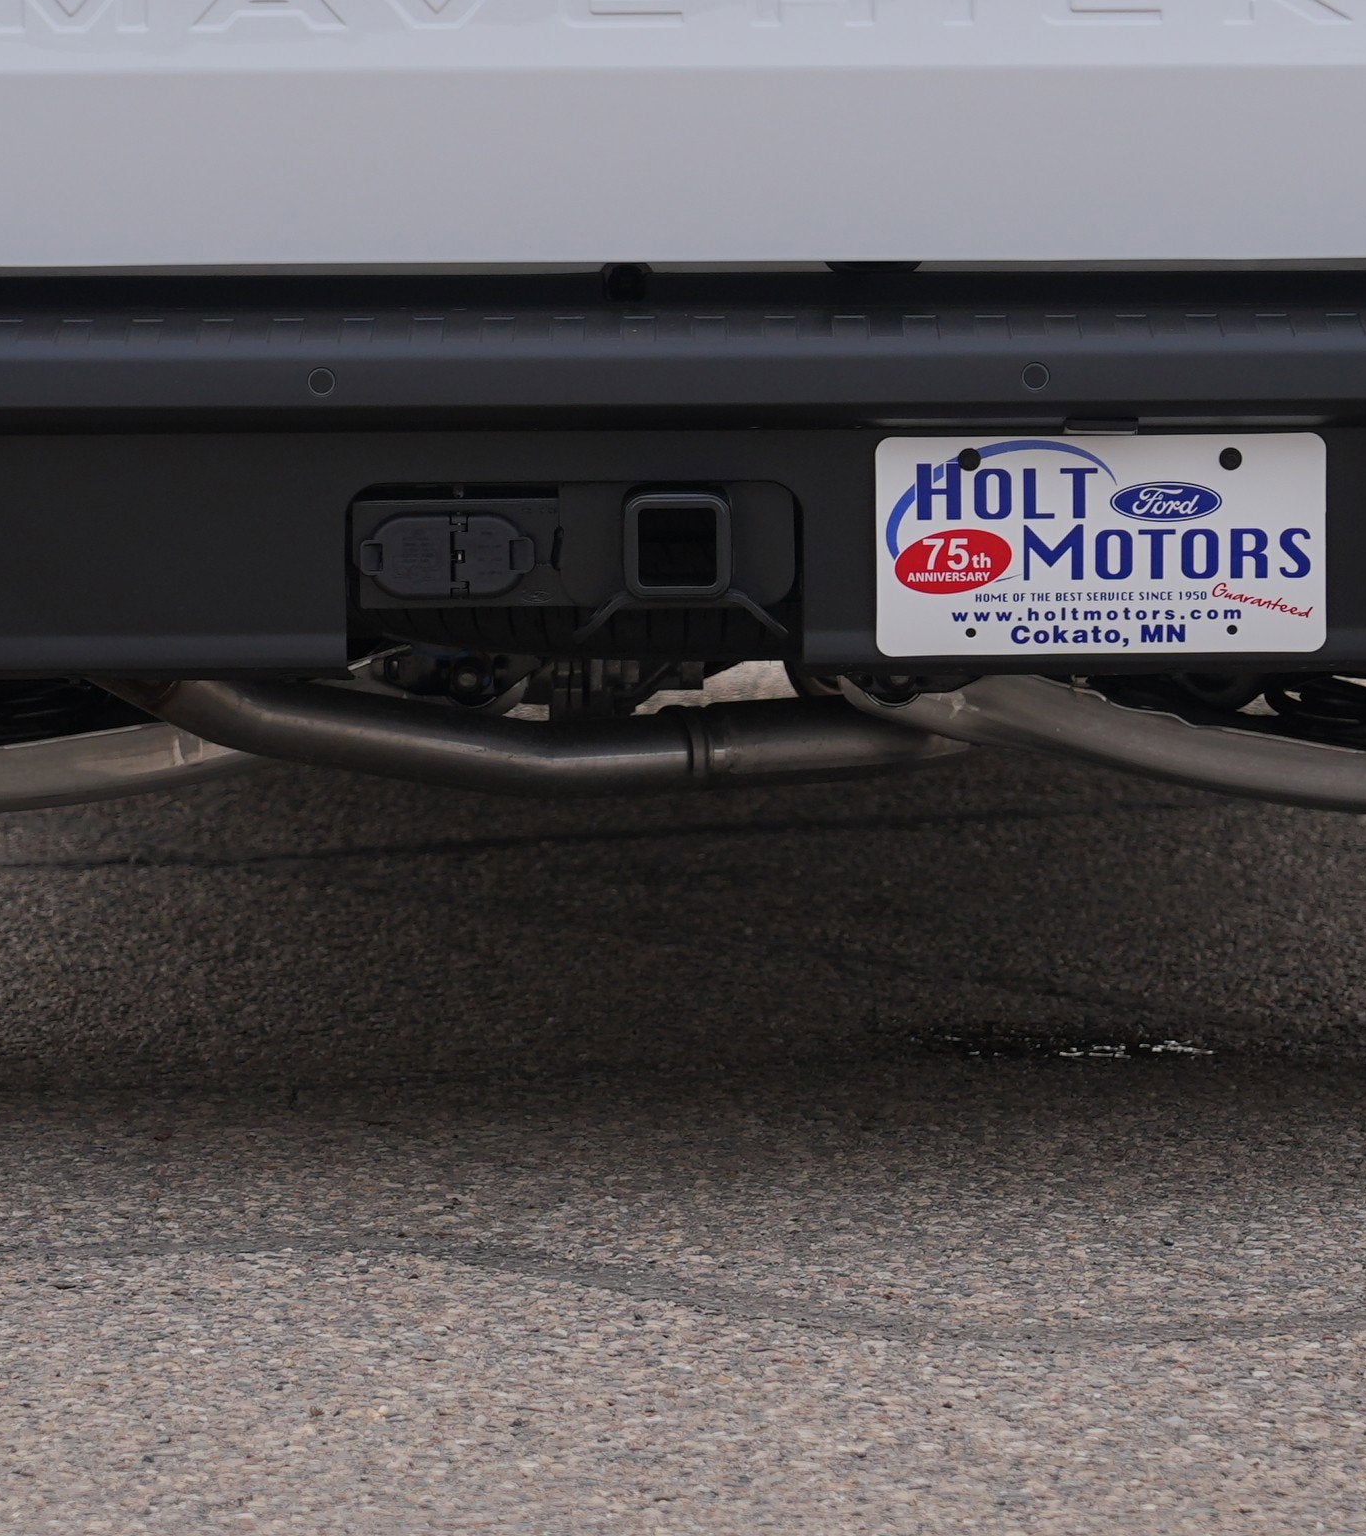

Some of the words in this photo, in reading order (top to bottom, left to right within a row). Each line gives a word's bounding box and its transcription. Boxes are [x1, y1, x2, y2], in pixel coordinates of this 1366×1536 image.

[916, 463, 1098, 520] HOLT
[1132, 487, 1200, 515] Ford
[923, 537, 992, 571] 75th
[1023, 524, 1311, 581] MOTORS
[907, 571, 990, 582] ANNIVERSARY
[975, 593, 1008, 602] HOME
[1013, 593, 1026, 602] OF
[1030, 593, 1051, 602] THE
[1055, 592, 1083, 602] BEST
[1087, 591, 1134, 602] SERVICE
[1139, 591, 1173, 601] SINCE
[1178, 591, 1207, 601] 1950
[1212, 582, 1313, 618] Guaranteed
[951, 607, 1242, 622] www.holtmotors.com
[1011, 625, 1129, 647] Cokato,
[1141, 624, 1186, 643] MN
